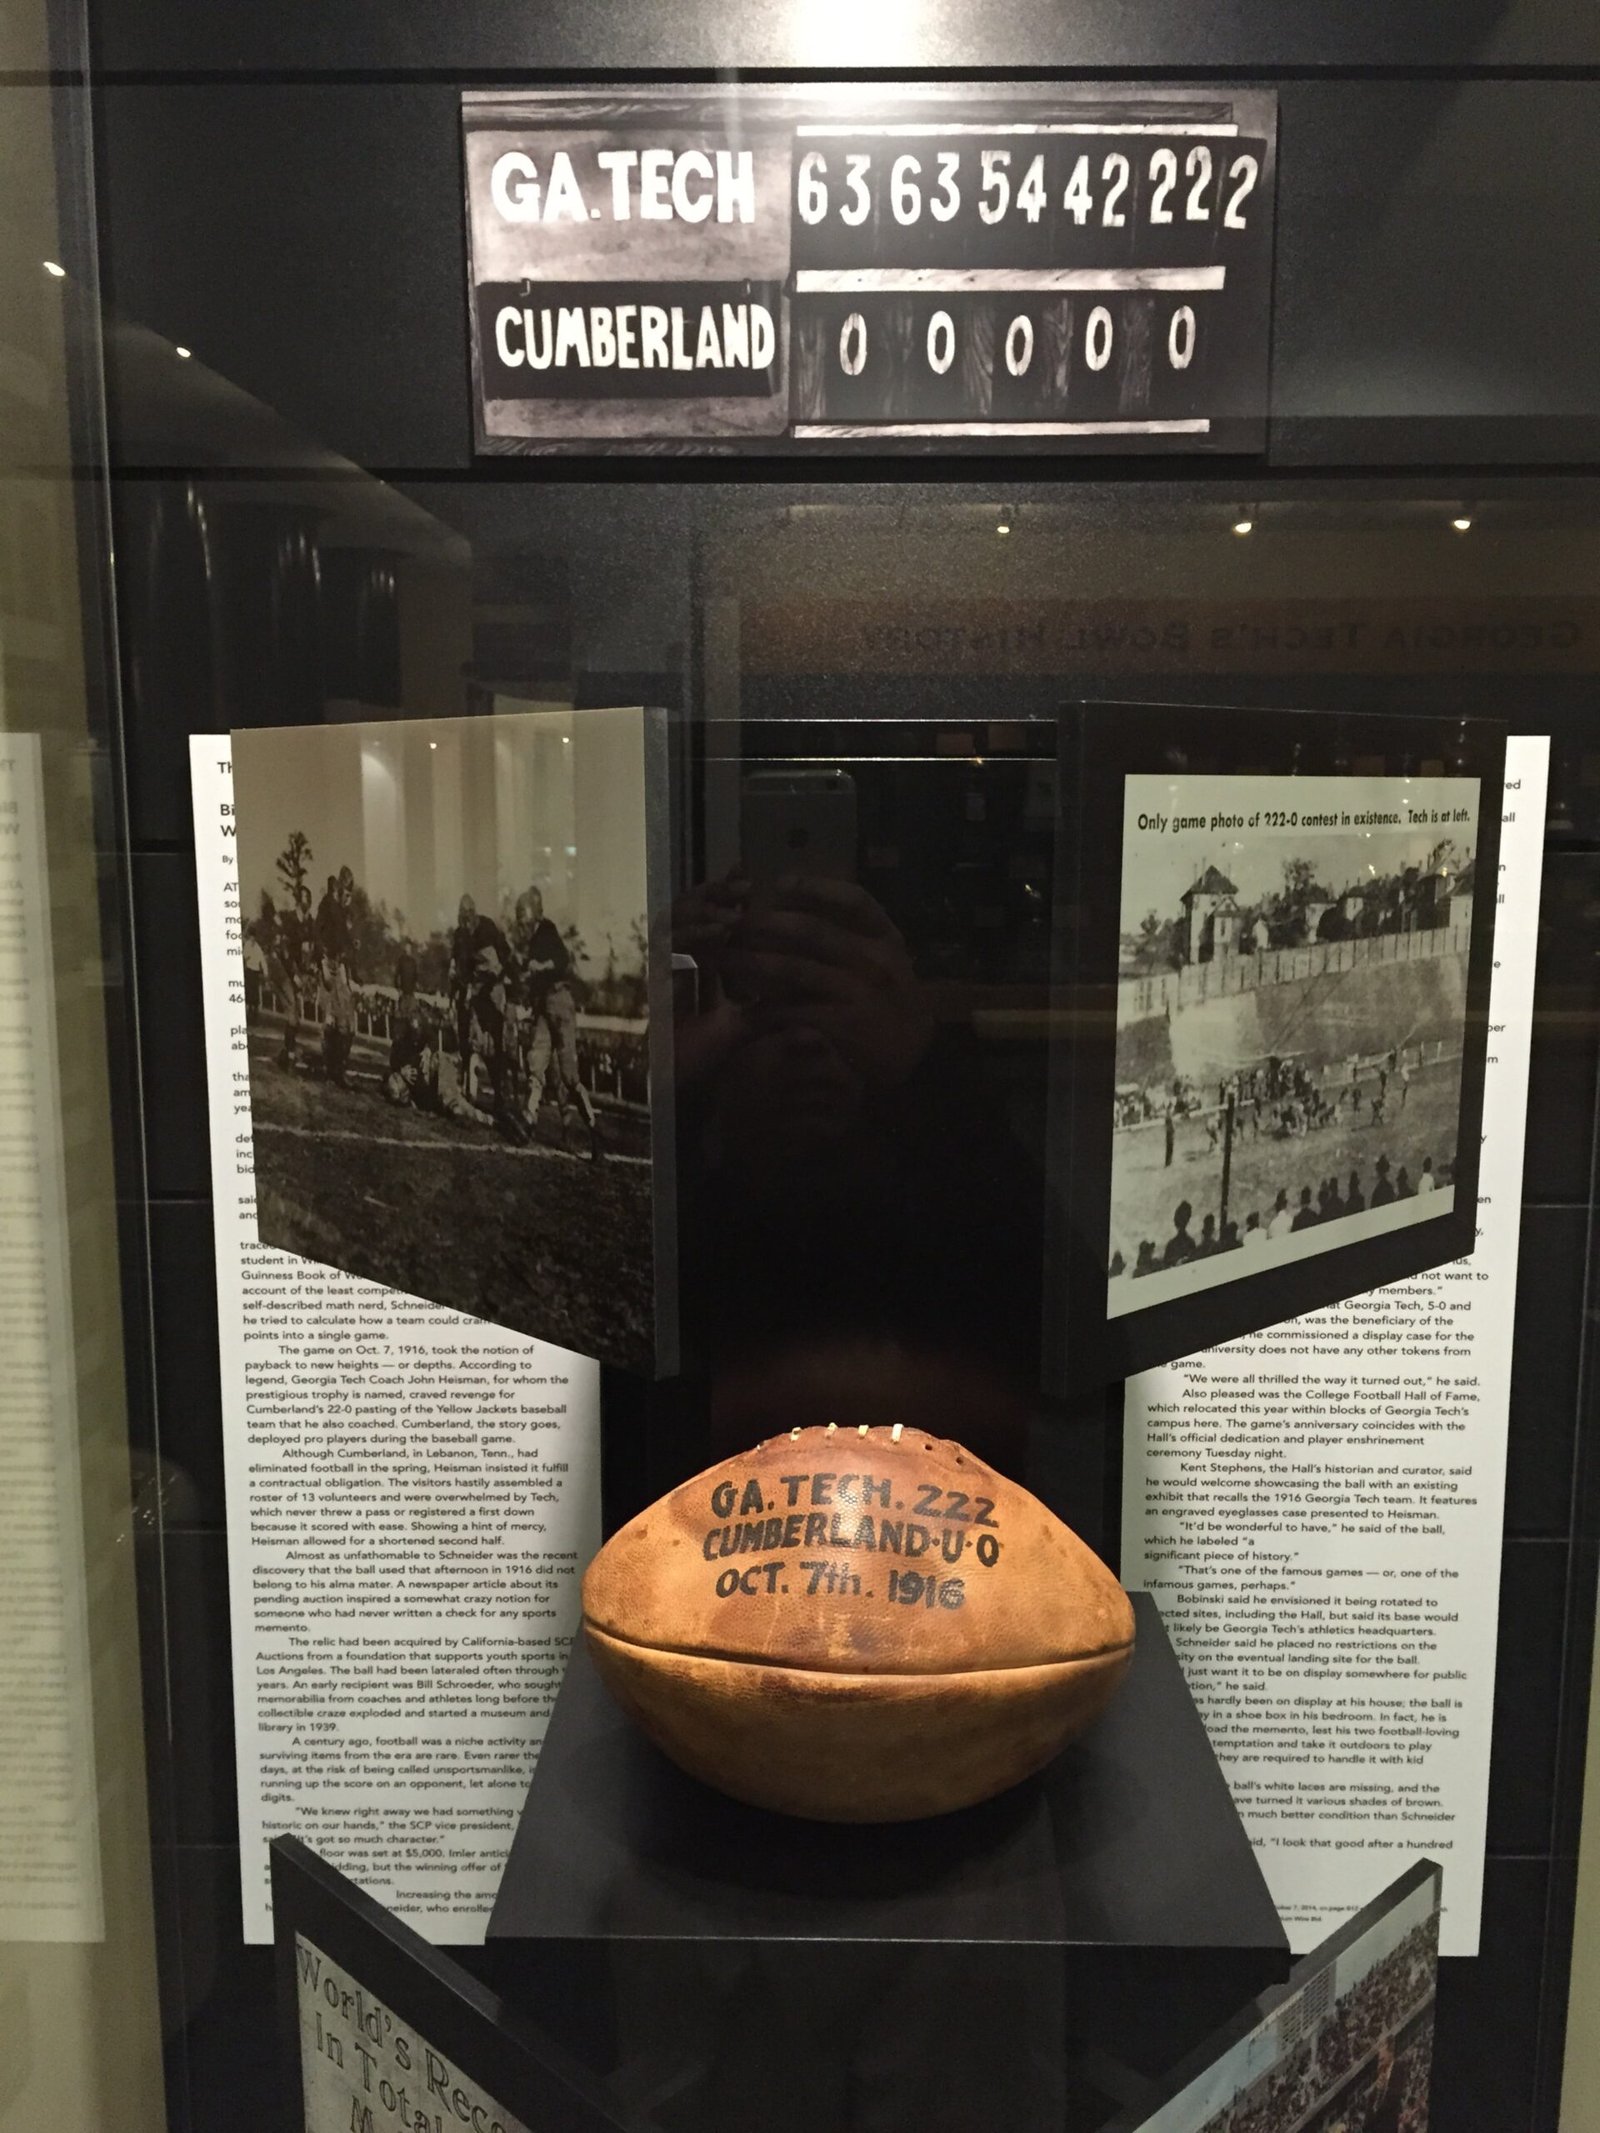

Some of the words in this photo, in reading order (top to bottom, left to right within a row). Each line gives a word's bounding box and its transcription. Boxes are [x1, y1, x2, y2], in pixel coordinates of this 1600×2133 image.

[495, 300, 776, 372] CUMBERLAND
[840, 312, 868, 378] 0
[927, 310, 956, 375] 0
[1006, 314, 1034, 376] 0
[1085, 305, 1114, 371] 0
[1170, 305, 1197, 370] 0
[1138, 813, 1168, 833] Only
[1172, 816, 1206, 833] game
[1211, 812, 1244, 832] photo
[1248, 812, 1260, 828] of
[1264, 811, 1298, 827] 222-0
[1301, 812, 1338, 826] contest
[1341, 811, 1350, 825] in
[1354, 810, 1402, 825] existence.
[1408, 809, 1428, 823] Tech
[1431, 809, 1438, 823] is
[1441, 810, 1450, 823] at
[1453, 808, 1470, 822] left.
[243, 1330, 280, 1342] points
[282, 1331, 305, 1340] into
[318, 1330, 352, 1342] single
[278, 1345, 300, 1355] The
[303, 1347, 335, 1357] game
[431, 1345, 458, 1355] took
[460, 1345, 480, 1355] the
[482, 1346, 519, 1355] notion
[522, 1345, 534, 1355] of
[291, 1374, 337, 1387] Georgia
[339, 1375, 366, 1384] Tech
[368, 1375, 405, 1384] Coach
[407, 1375, 435, 1384] John
[493, 1374, 510, 1384] for
[512, 1375, 547, 1384] whom
[550, 1375, 569, 1384] the
[1242, 1374, 1255, 1383] all
[1258, 1374, 1299, 1384] thrilled
[1302, 1374, 1321, 1384] the
[1324, 1377, 1347, 1387] way
[1350, 1376, 1358, 1385] it
[1361, 1375, 1400, 1385] turned
[1436, 1376, 1451, 1386] he
[1182, 1388, 1207, 1398] Also
[1210, 1388, 1255, 1401] pleased
[1283, 1389, 1302, 1399] the
[1305, 1389, 1350, 1402] College
[1353, 1390, 1401, 1400] Football
[1404, 1391, 1427, 1400] Hall
[1430, 1391, 1442, 1401] of
[327, 1404, 352, 1414] 22-0
[355, 1405, 397, 1416] pasting
[399, 1404, 412, 1414] of
[414, 1404, 434, 1414] the
[436, 1404, 473, 1414] Yellow
[475, 1404, 518, 1414] Jackets
[520, 1404, 567, 1414] baseball
[1147, 1420, 1191, 1430] campus
[1225, 1418, 1247, 1428] The
[1293, 1420, 1359, 1432] anniversary
[1362, 1420, 1415, 1430] coincides
[1418, 1421, 1443, 1431] with
[1446, 1421, 1466, 1431] the
[282, 1448, 334, 1460] Although
[412, 1449, 423, 1458] in
[517, 1448, 539, 1458] had
[1180, 1463, 1207, 1472] Kent
[1269, 1463, 1288, 1473] the
[1324, 1464, 1374, 1474] historian
[1377, 1465, 1399, 1475] and
[1449, 1465, 1472, 1476] said
[251, 1537, 300, 1546] Heisman
[303, 1536, 346, 1545] allowed
[349, 1535, 366, 1546] for
[378, 1536, 435, 1545] shortened
[438, 1536, 478, 1545] second
[252, 1565, 305, 1577] discovery
[308, 1565, 331, 1574] that
[333, 1565, 353, 1574] the
[355, 1565, 376, 1574] ball
[378, 1565, 406, 1574] used
[408, 1565, 431, 1574] that
[434, 1564, 489, 1574] afternoon
[491, 1565, 502, 1574] in
[505, 1565, 533, 1574] 1916
[535, 1565, 553, 1574] did
[556, 1566, 576, 1575] not
[889, 1568, 966, 1610] 1916
[1177, 1594, 1224, 1604] Bobinski
[1227, 1594, 1250, 1604] said
[1253, 1595, 1267, 1605] he
[1270, 1595, 1331, 1605] envisioned
[1334, 1597, 1341, 1605] it
[1345, 1596, 1377, 1608] being
[1380, 1597, 1423, 1607] rotated
[1425, 1599, 1438, 1607] to
[258, 1722, 293, 1734] library
[296, 1723, 306, 1731] in
[315, 2011, 343, 2069] In
